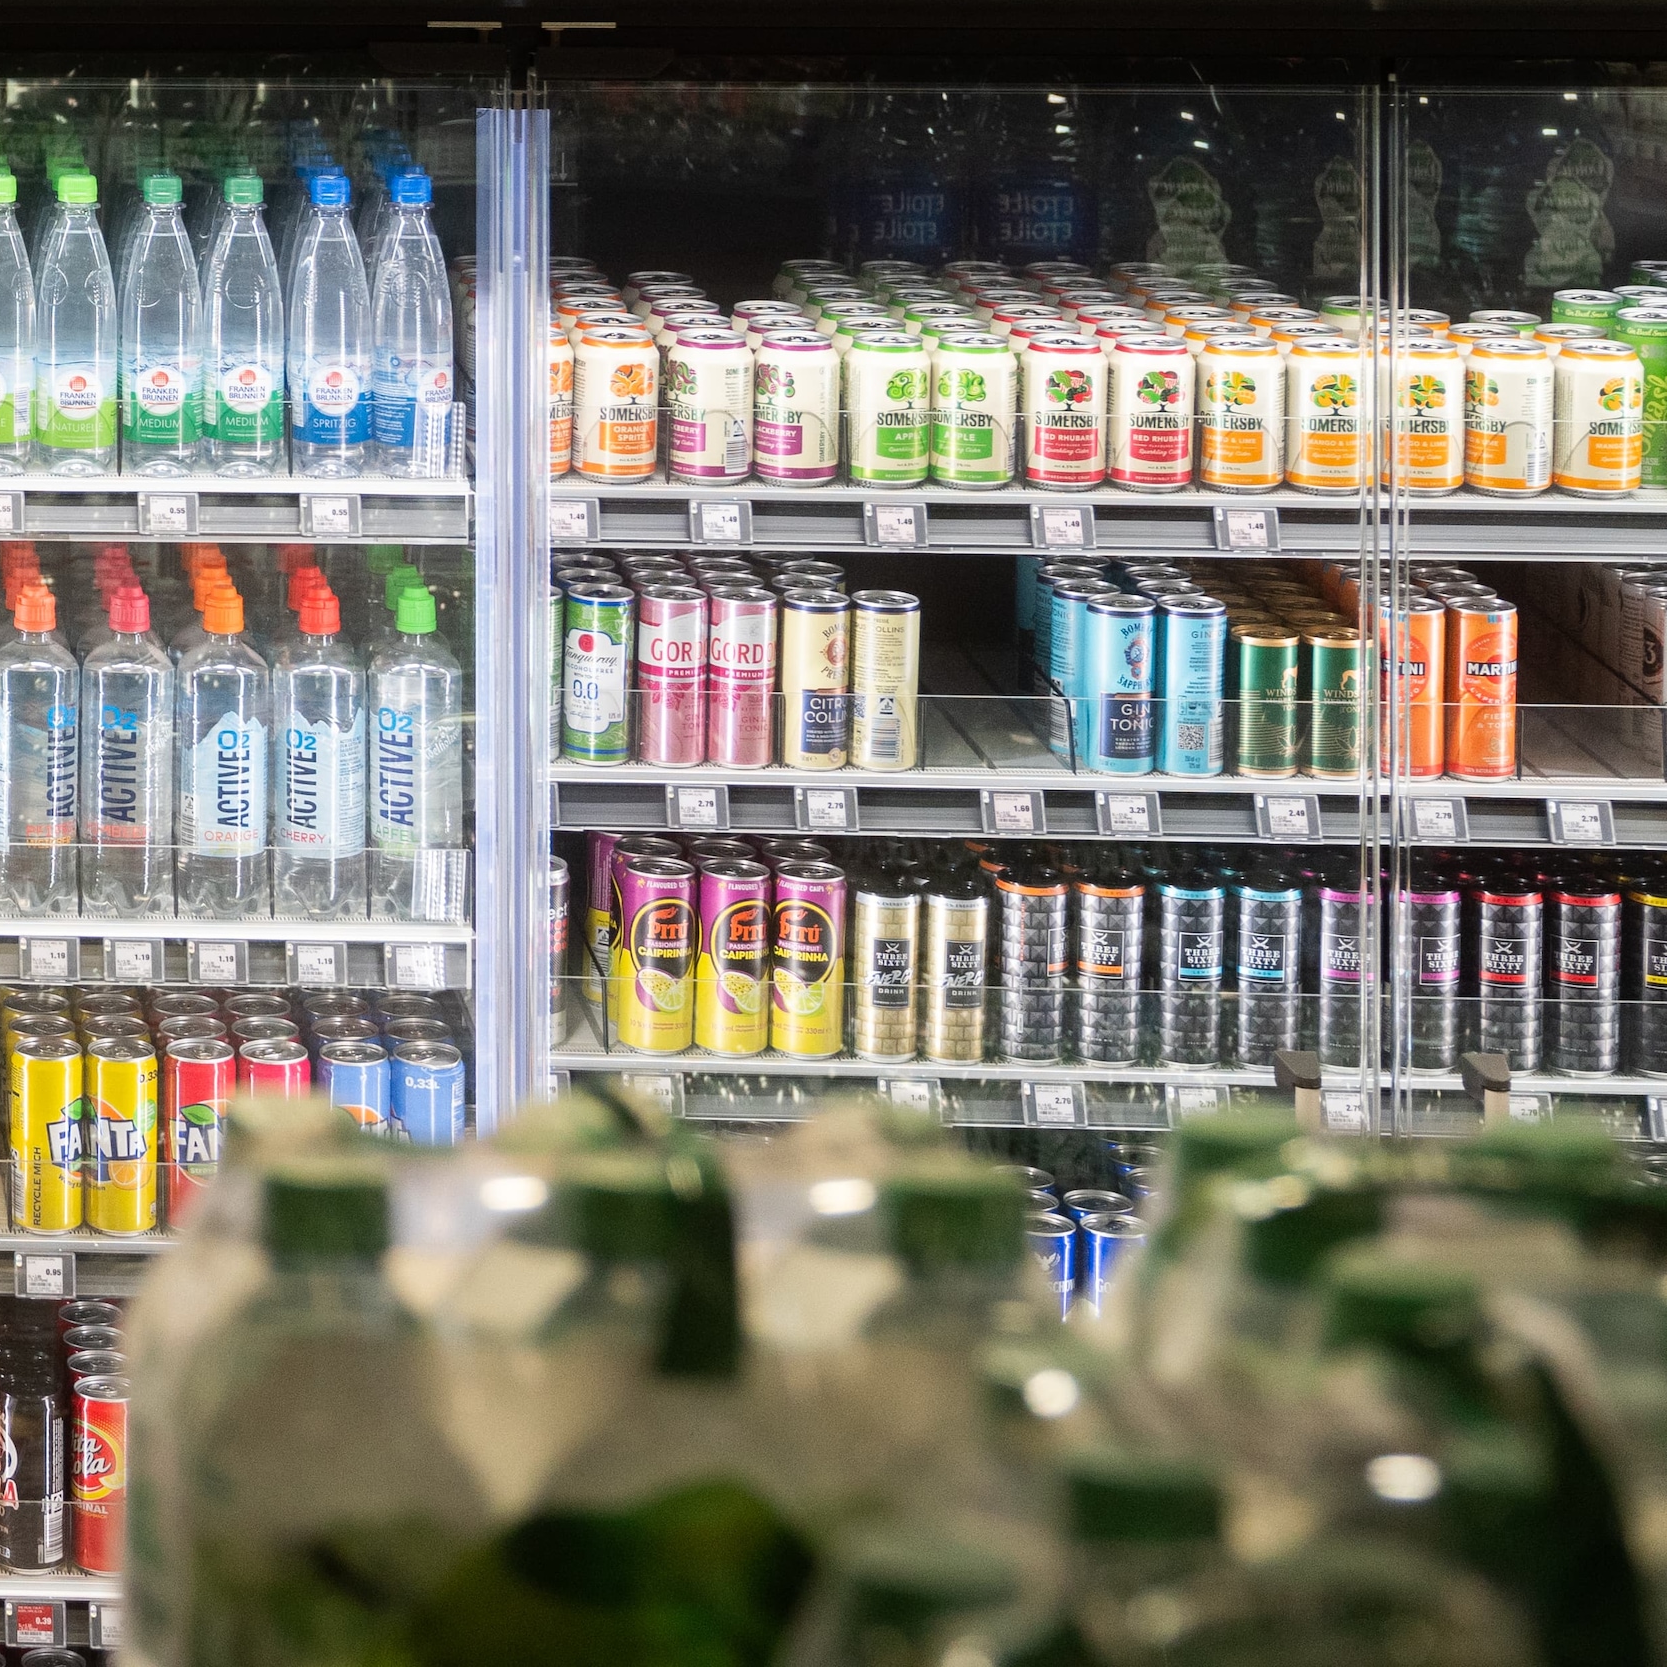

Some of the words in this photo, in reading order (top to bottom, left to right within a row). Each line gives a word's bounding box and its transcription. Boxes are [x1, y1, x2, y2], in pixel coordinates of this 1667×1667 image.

[142, 387, 179, 395] FRANKEN
[228, 385, 266, 393] FRANKEN
[316, 386, 353, 394] FRANKEN
[59, 391, 97, 400] FRANKEN
[142, 394, 179, 402] BRUNNEN
[228, 393, 266, 401] BRUNNEN
[138, 418, 181, 429] MEDIUM
[225, 415, 270, 427] MEDIUM
[312, 418, 358, 430] SPRITZIG
[53, 421, 104, 433] NATURELLE
[169, 507, 186, 515] 0.55
[724, 668, 764, 678] PREMIUM
[573, 679, 599, 701] 0.0
[1121, 702, 1151, 716] GIN
[100, 729, 137, 824] ACTIVE
[217, 749, 250, 828] ACTIVE
[285, 748, 318, 830] ACTIVE
[698, 800, 714, 808] 2.79
[1129, 806, 1146, 814] 3.29
[1289, 809, 1305, 817] 2.49
[1435, 812, 1452, 820] 2.79
[203, 829, 259, 842] ORANGE
[280, 829, 327, 844] CHERRY
[647, 914, 688, 940] PITÚ
[779, 916, 821, 941] PITÚ
[876, 952, 908, 961] THREE
[1184, 947, 1221, 957] THREE
[948, 954, 980, 963] THREE
[1187, 955, 1218, 964] SIXTY
[1483, 952, 1525, 963] THREE
[1553, 954, 1594, 964] THREE
[877, 959, 907, 968] SIXTY
[1486, 961, 1523, 971] SIXTY
[1556, 962, 1591, 972] SIXTY
[865, 969, 913, 986] ENERGY
[941, 969, 986, 988] ENERGY
[877, 987, 905, 995] DRINK
[1054, 1097, 1071, 1105] 2.79
[34, 1178, 42, 1226] RECYCLE
[45, 1268, 62, 1276] 0.95
[35, 1616, 52, 1625] 0.39
